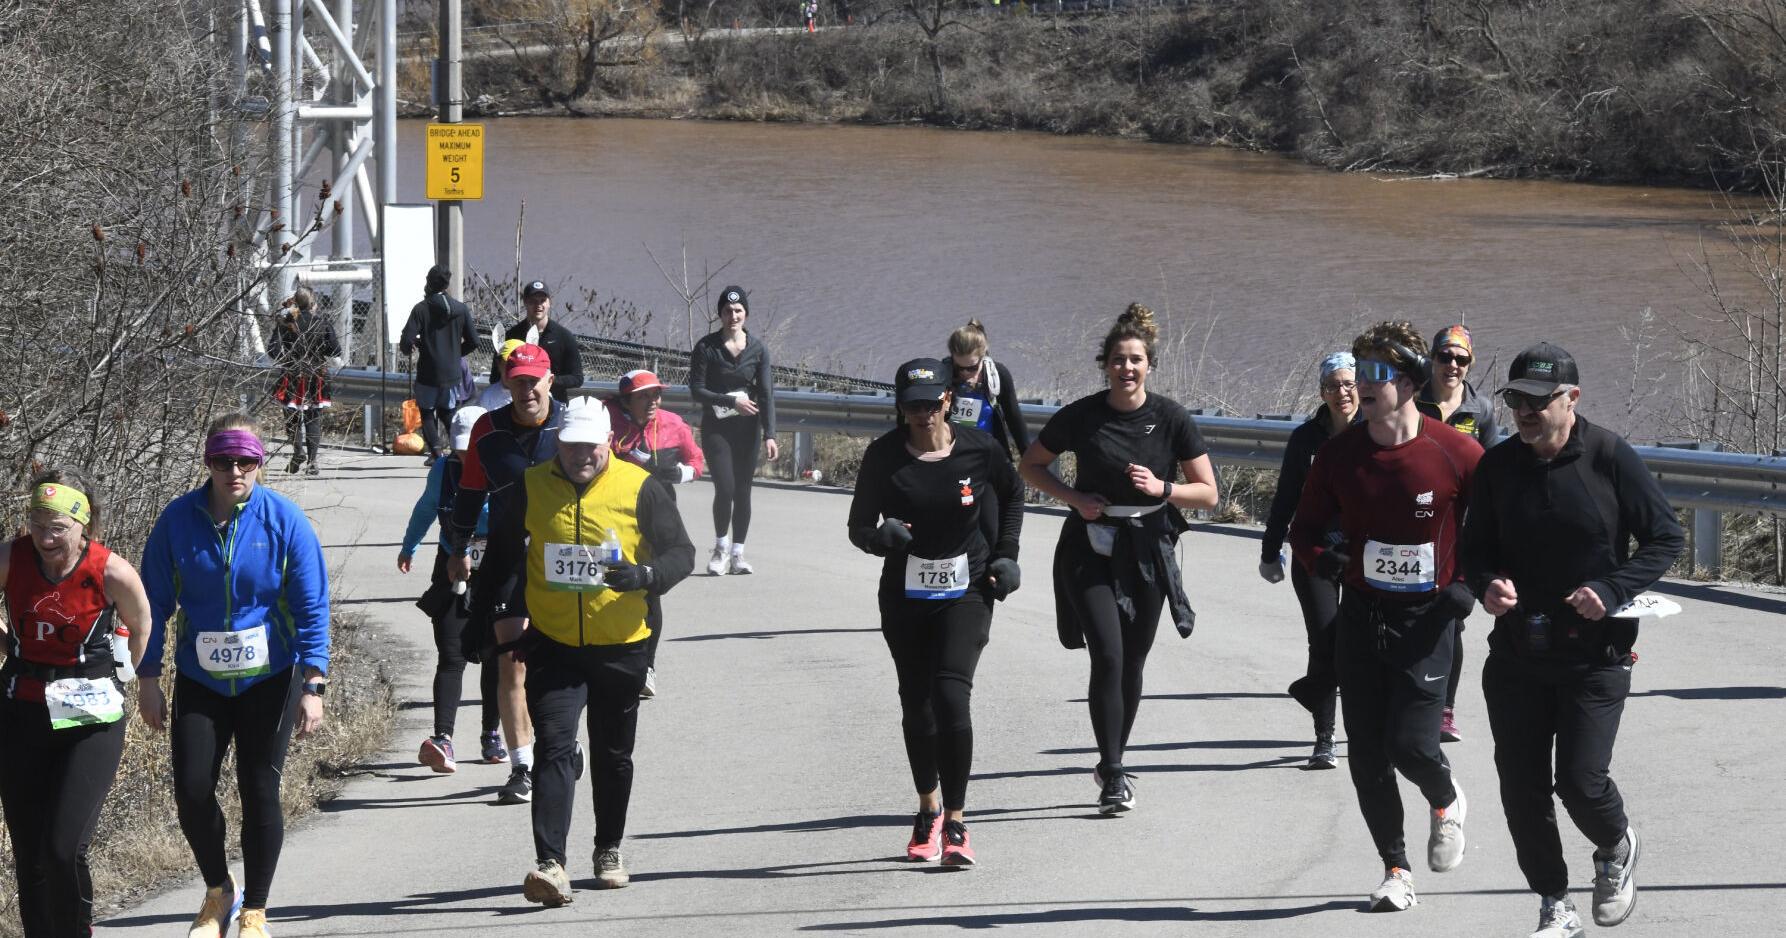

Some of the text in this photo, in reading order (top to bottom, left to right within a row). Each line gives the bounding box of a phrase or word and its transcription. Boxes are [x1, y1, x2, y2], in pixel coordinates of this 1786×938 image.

[430, 129, 481, 137] BRIDGE AHEAD
[439, 142, 471, 150] MAXIMUM
[443, 155, 467, 163] WEIGHT
[450, 167, 461, 183] 5
[1415, 510, 1434, 518] CN
[1400, 549, 1419, 557] CN
[555, 559, 598, 577] 3176
[1375, 558, 1422, 576] 2344
[918, 570, 957, 584] 1781
[209, 645, 256, 664] 4978
[61, 691, 111, 708] 4983
